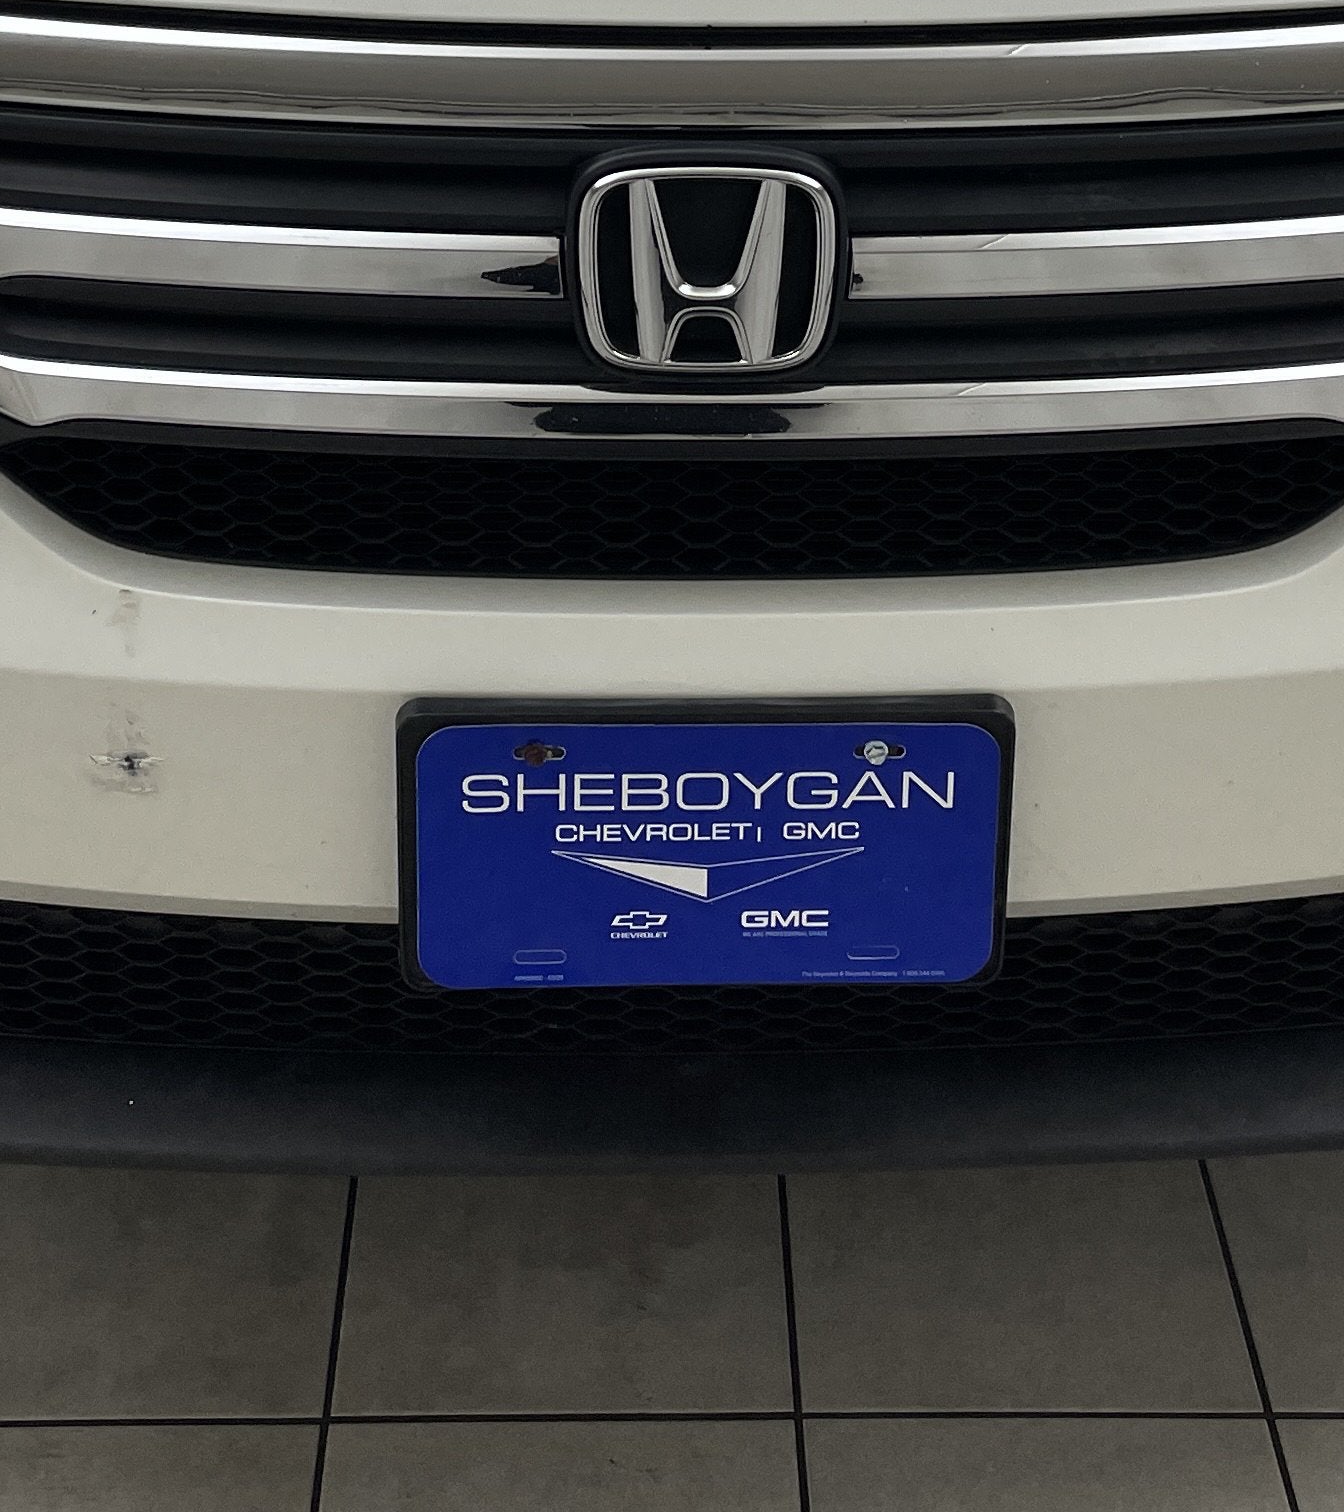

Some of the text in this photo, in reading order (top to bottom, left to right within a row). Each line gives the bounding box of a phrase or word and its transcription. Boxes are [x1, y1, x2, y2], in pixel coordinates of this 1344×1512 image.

[461, 769, 956, 813] SHEBOYGAN
[555, 820, 861, 842] CHEVROLET GMC
[740, 909, 829, 928] GMC
[610, 931, 668, 939] CHEVROLET
